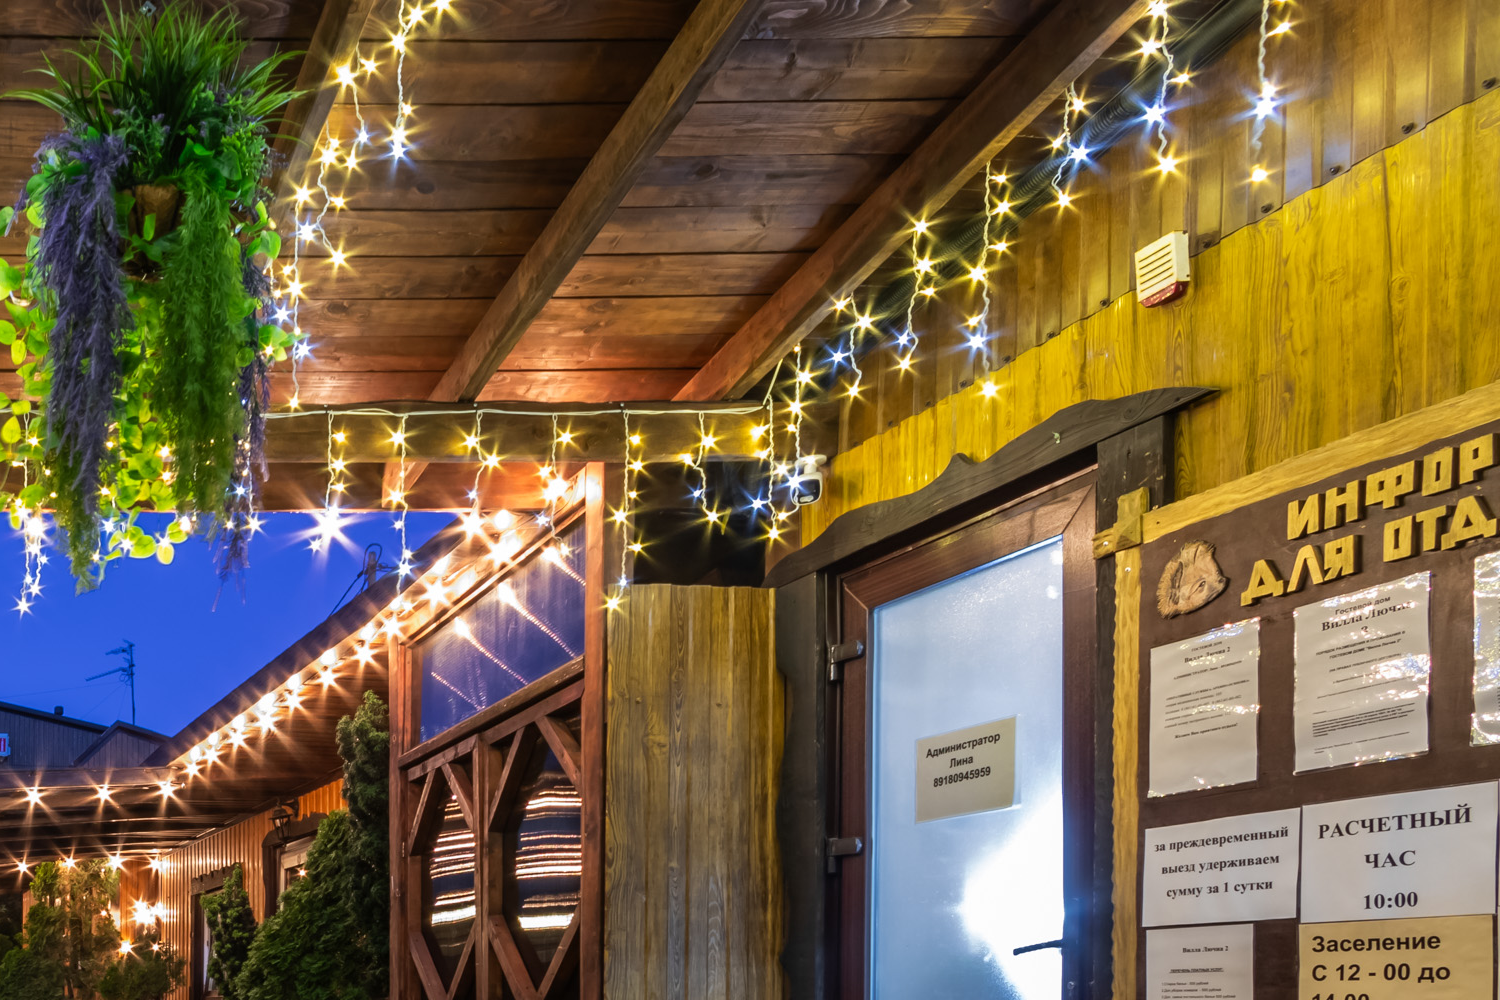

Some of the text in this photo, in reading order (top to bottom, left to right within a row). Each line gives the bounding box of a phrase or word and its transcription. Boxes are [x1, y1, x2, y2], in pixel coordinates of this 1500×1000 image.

[1287, 432, 1496, 541] ИНФОР
[1240, 495, 1498, 607] ДЛЯ ОТД
[1374, 596, 1391, 606] дом
[1321, 615, 1363, 631] Вилла
[926, 733, 1001, 758] Администратор
[949, 756, 974, 768] Лина
[933, 766, 991, 788] 89180945959
[1318, 803, 1473, 840] РАСЧЕТНЫЙ
[1154, 826, 1289, 852] за преждевременный
[1161, 855, 1280, 875] выезд удерживаем
[1364, 850, 1417, 869] ЧАС
[1166, 881, 1273, 900] сумму за 1 сутки
[1364, 891, 1419, 910] 10:00
[1311, 934, 1441, 953] Заселение
[1312, 964, 1328, 981] С
[1335, 964, 1361, 981] 12
[1383, 963, 1411, 981] 00
[1417, 965, 1451, 984] до
